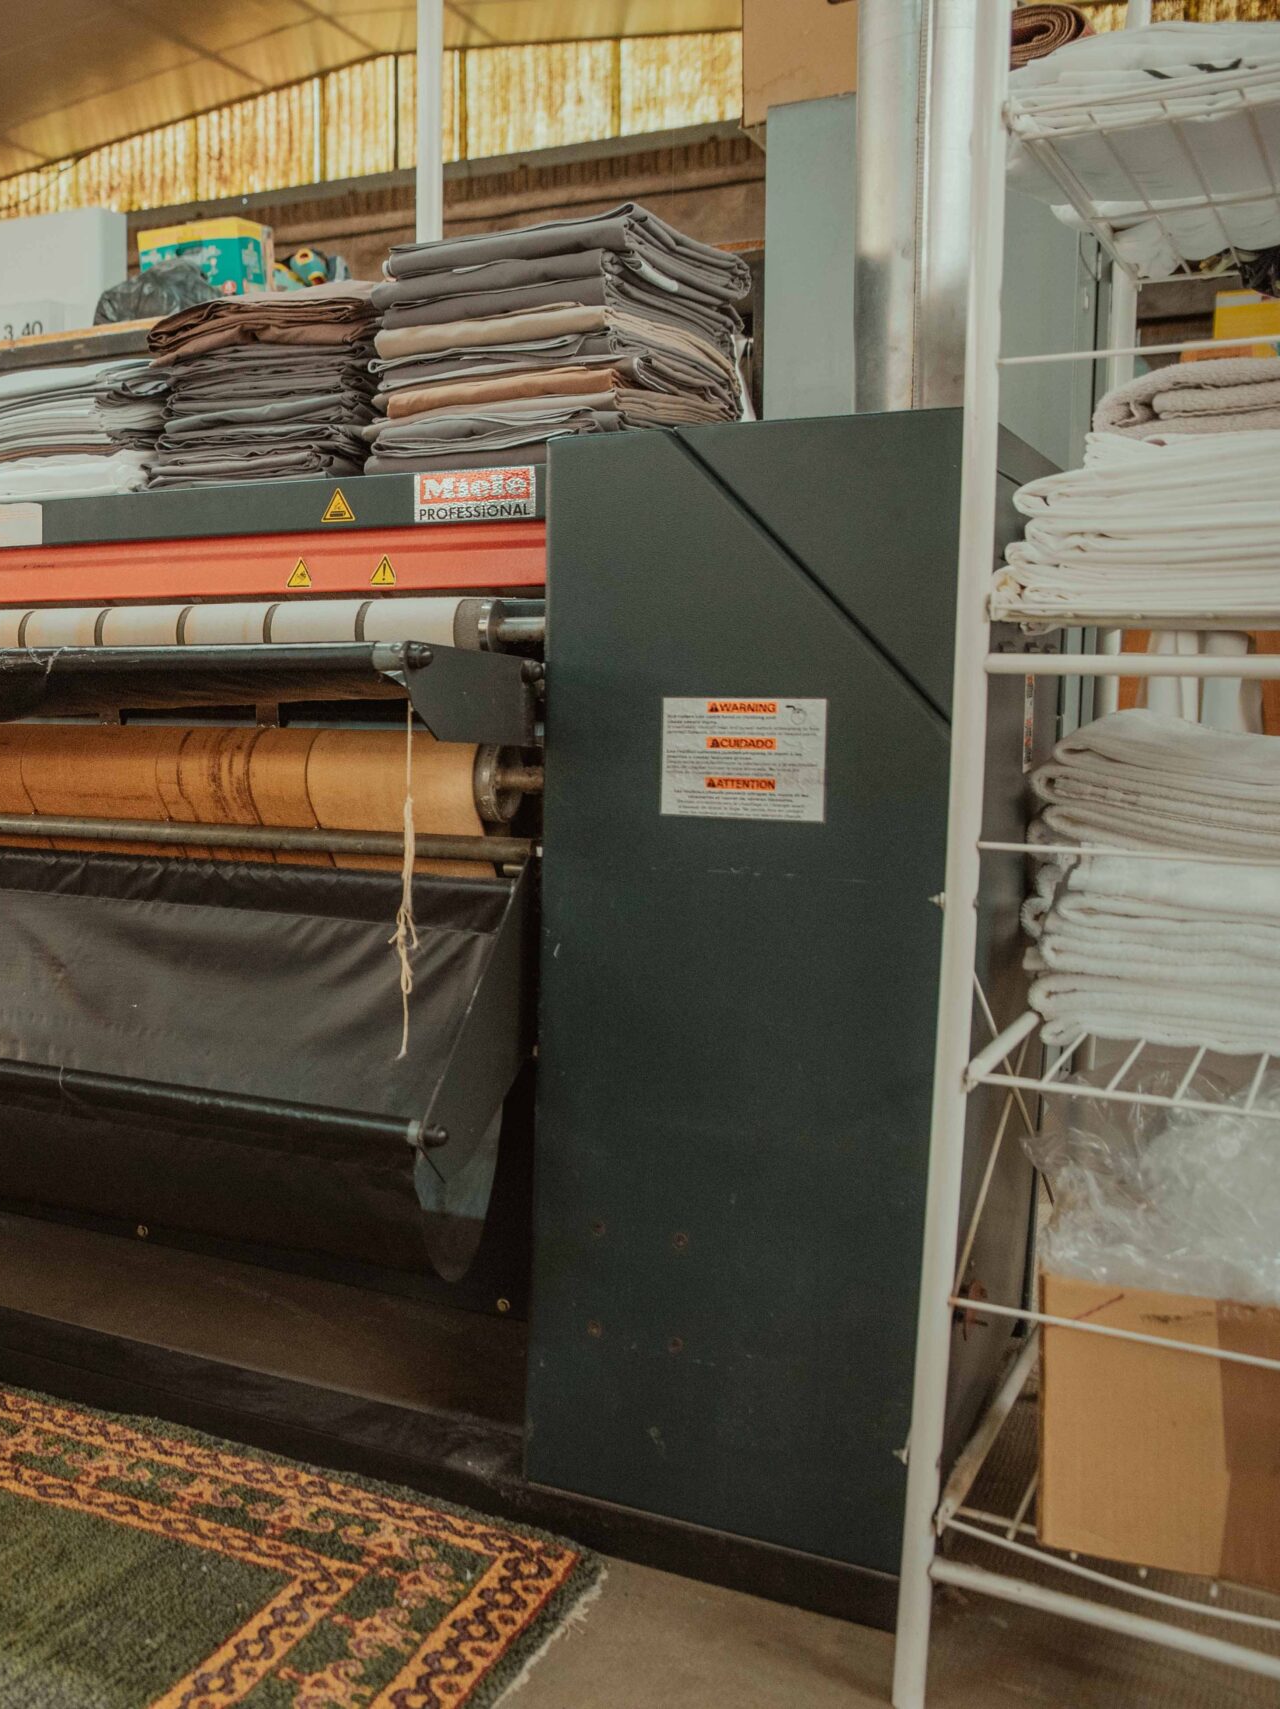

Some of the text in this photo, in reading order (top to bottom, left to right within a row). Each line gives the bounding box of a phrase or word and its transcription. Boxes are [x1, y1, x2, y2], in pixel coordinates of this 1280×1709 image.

[423, 475, 528, 499] Miele
[419, 504, 530, 521] PROFESSIONAL
[720, 703, 776, 713] WARNING
[720, 739, 775, 749] CUIDADO
[717, 779, 776, 790] ATTENTION
